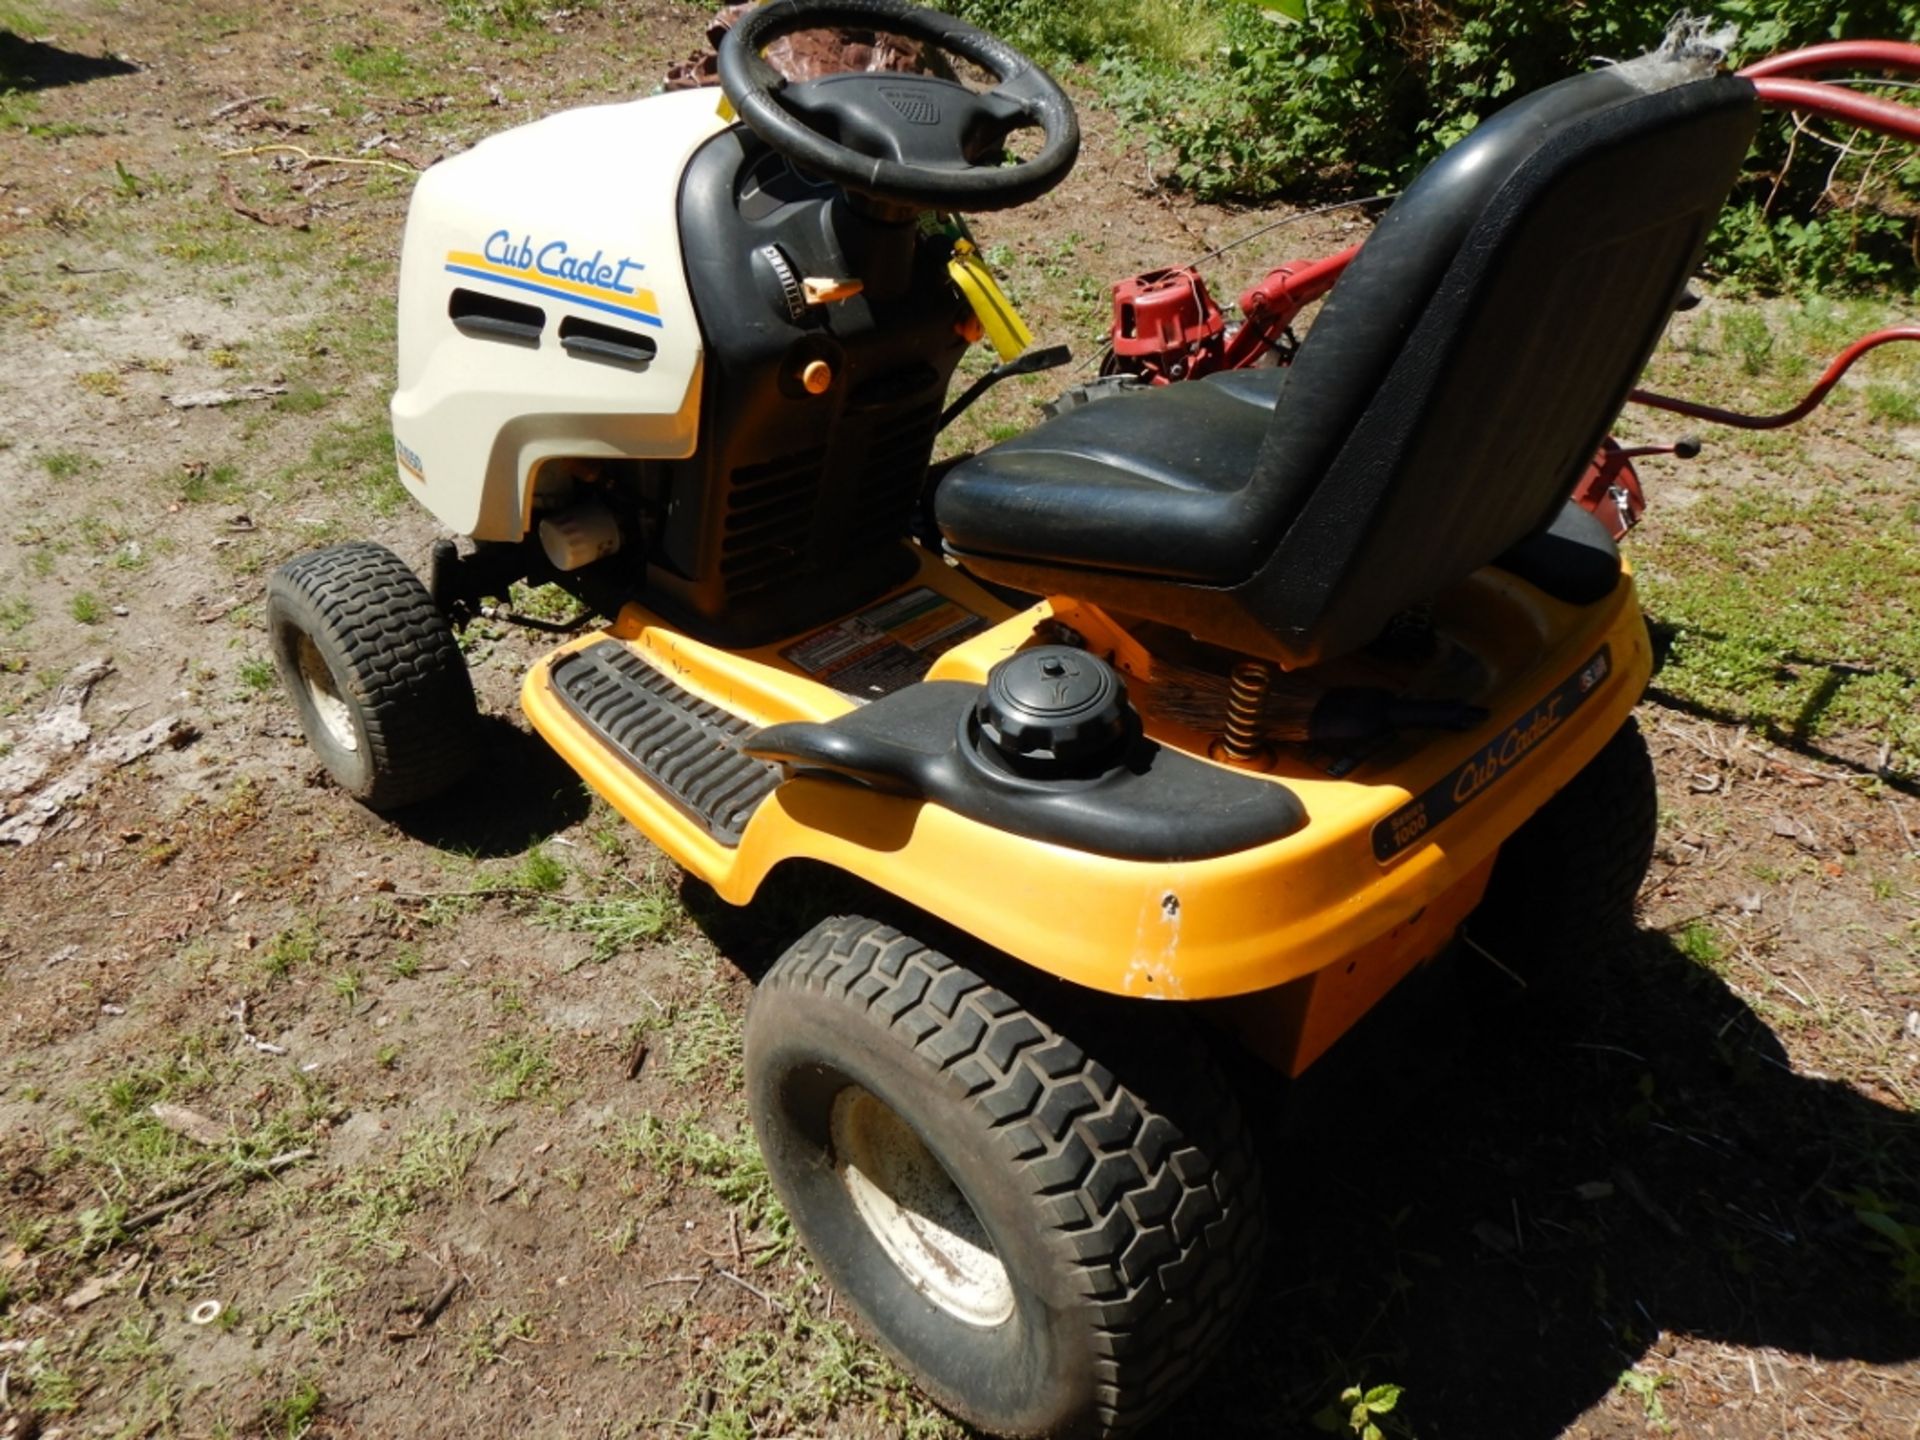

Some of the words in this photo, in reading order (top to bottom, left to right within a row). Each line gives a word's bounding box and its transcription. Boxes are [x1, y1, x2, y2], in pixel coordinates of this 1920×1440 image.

[484, 229, 533, 270] Cub
[536, 240, 645, 294] Cadet
[1453, 749, 1499, 803] Cub
[1500, 695, 1564, 767] Cadet
[1392, 813, 1428, 848] 1000
